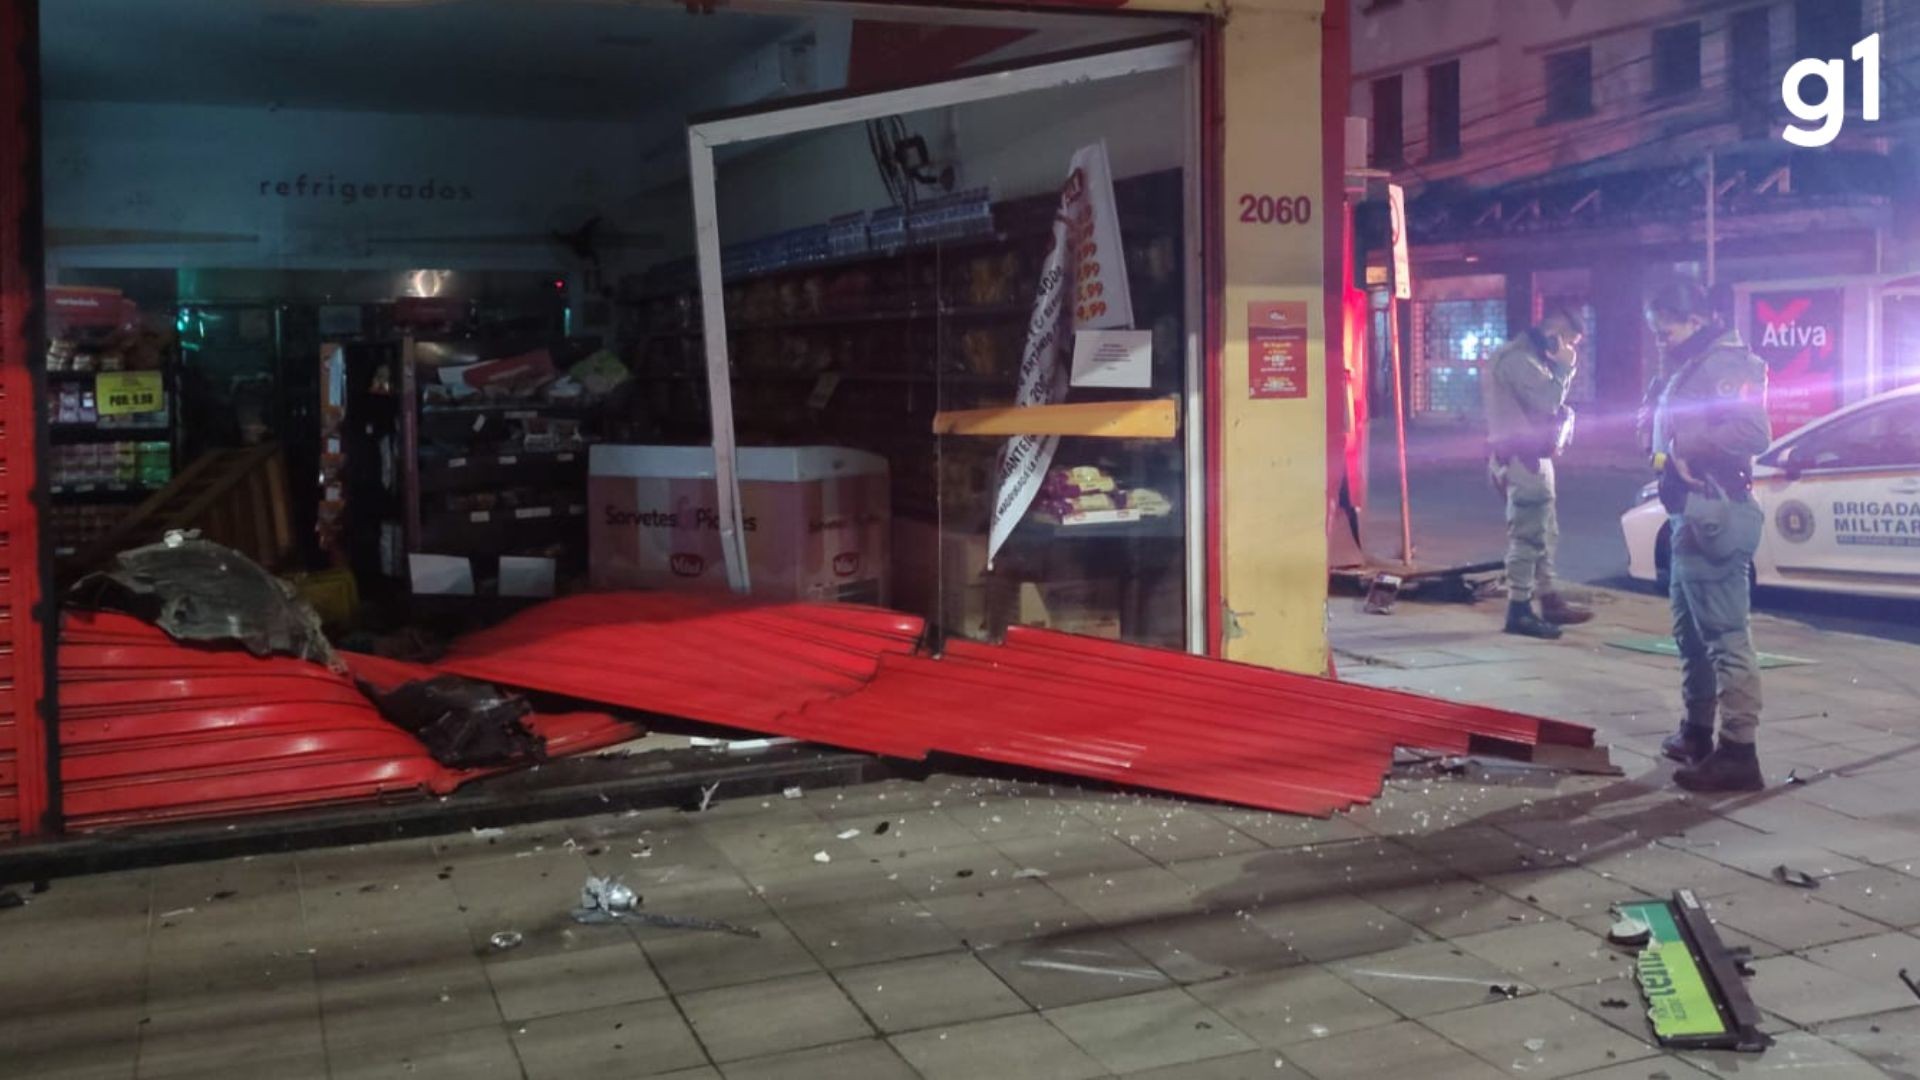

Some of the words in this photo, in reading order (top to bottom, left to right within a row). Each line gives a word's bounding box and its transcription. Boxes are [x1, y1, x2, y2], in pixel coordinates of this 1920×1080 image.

[259, 174, 474, 203] refrigerados
[1239, 194, 1311, 225] 2060
[1762, 320, 1826, 347] Ativa
[605, 504, 678, 528] Sorvetes
[1833, 501, 1920, 516] BRIGADA
[1834, 517, 1920, 534] MILITAR
